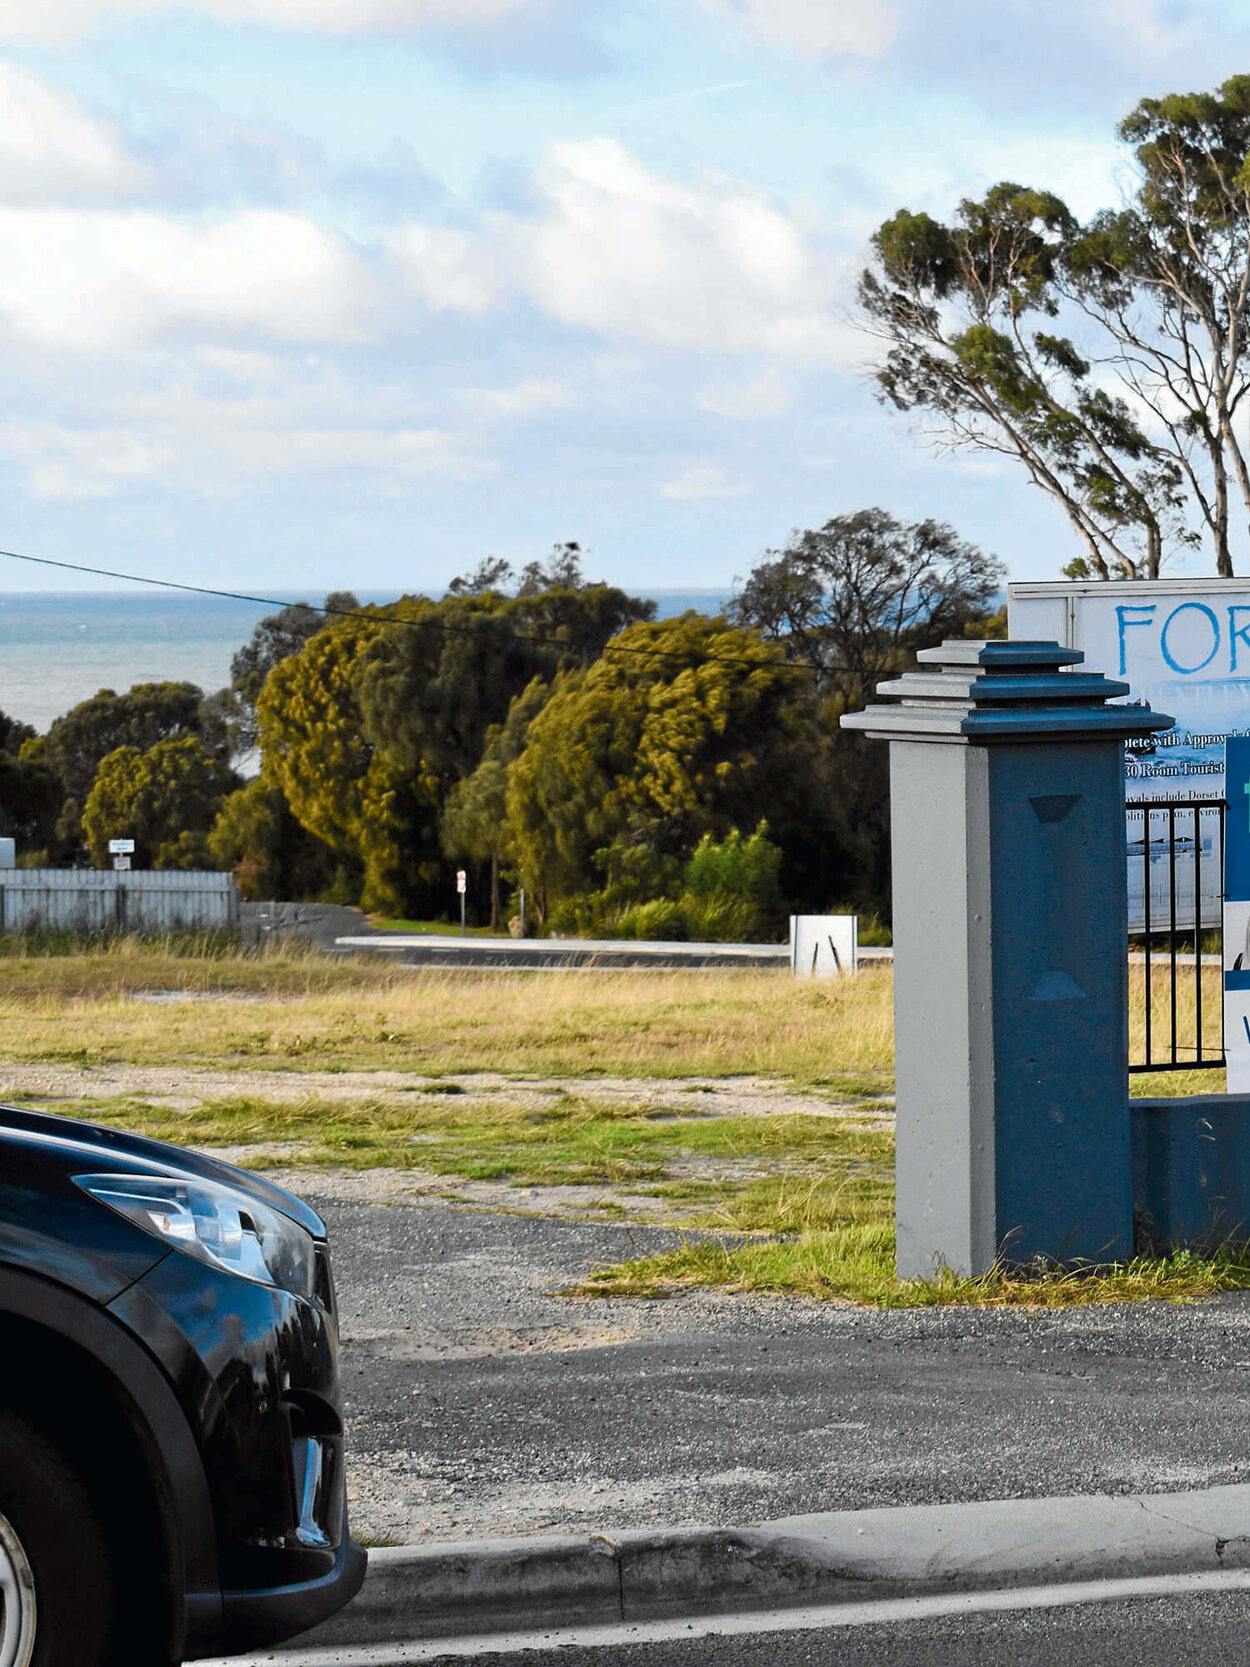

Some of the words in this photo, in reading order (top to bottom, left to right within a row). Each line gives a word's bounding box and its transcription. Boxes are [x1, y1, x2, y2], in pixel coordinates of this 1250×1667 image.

[1152, 731, 1181, 747] with
[1140, 763, 1178, 777] Room
[1181, 760, 1225, 775] Tourist
